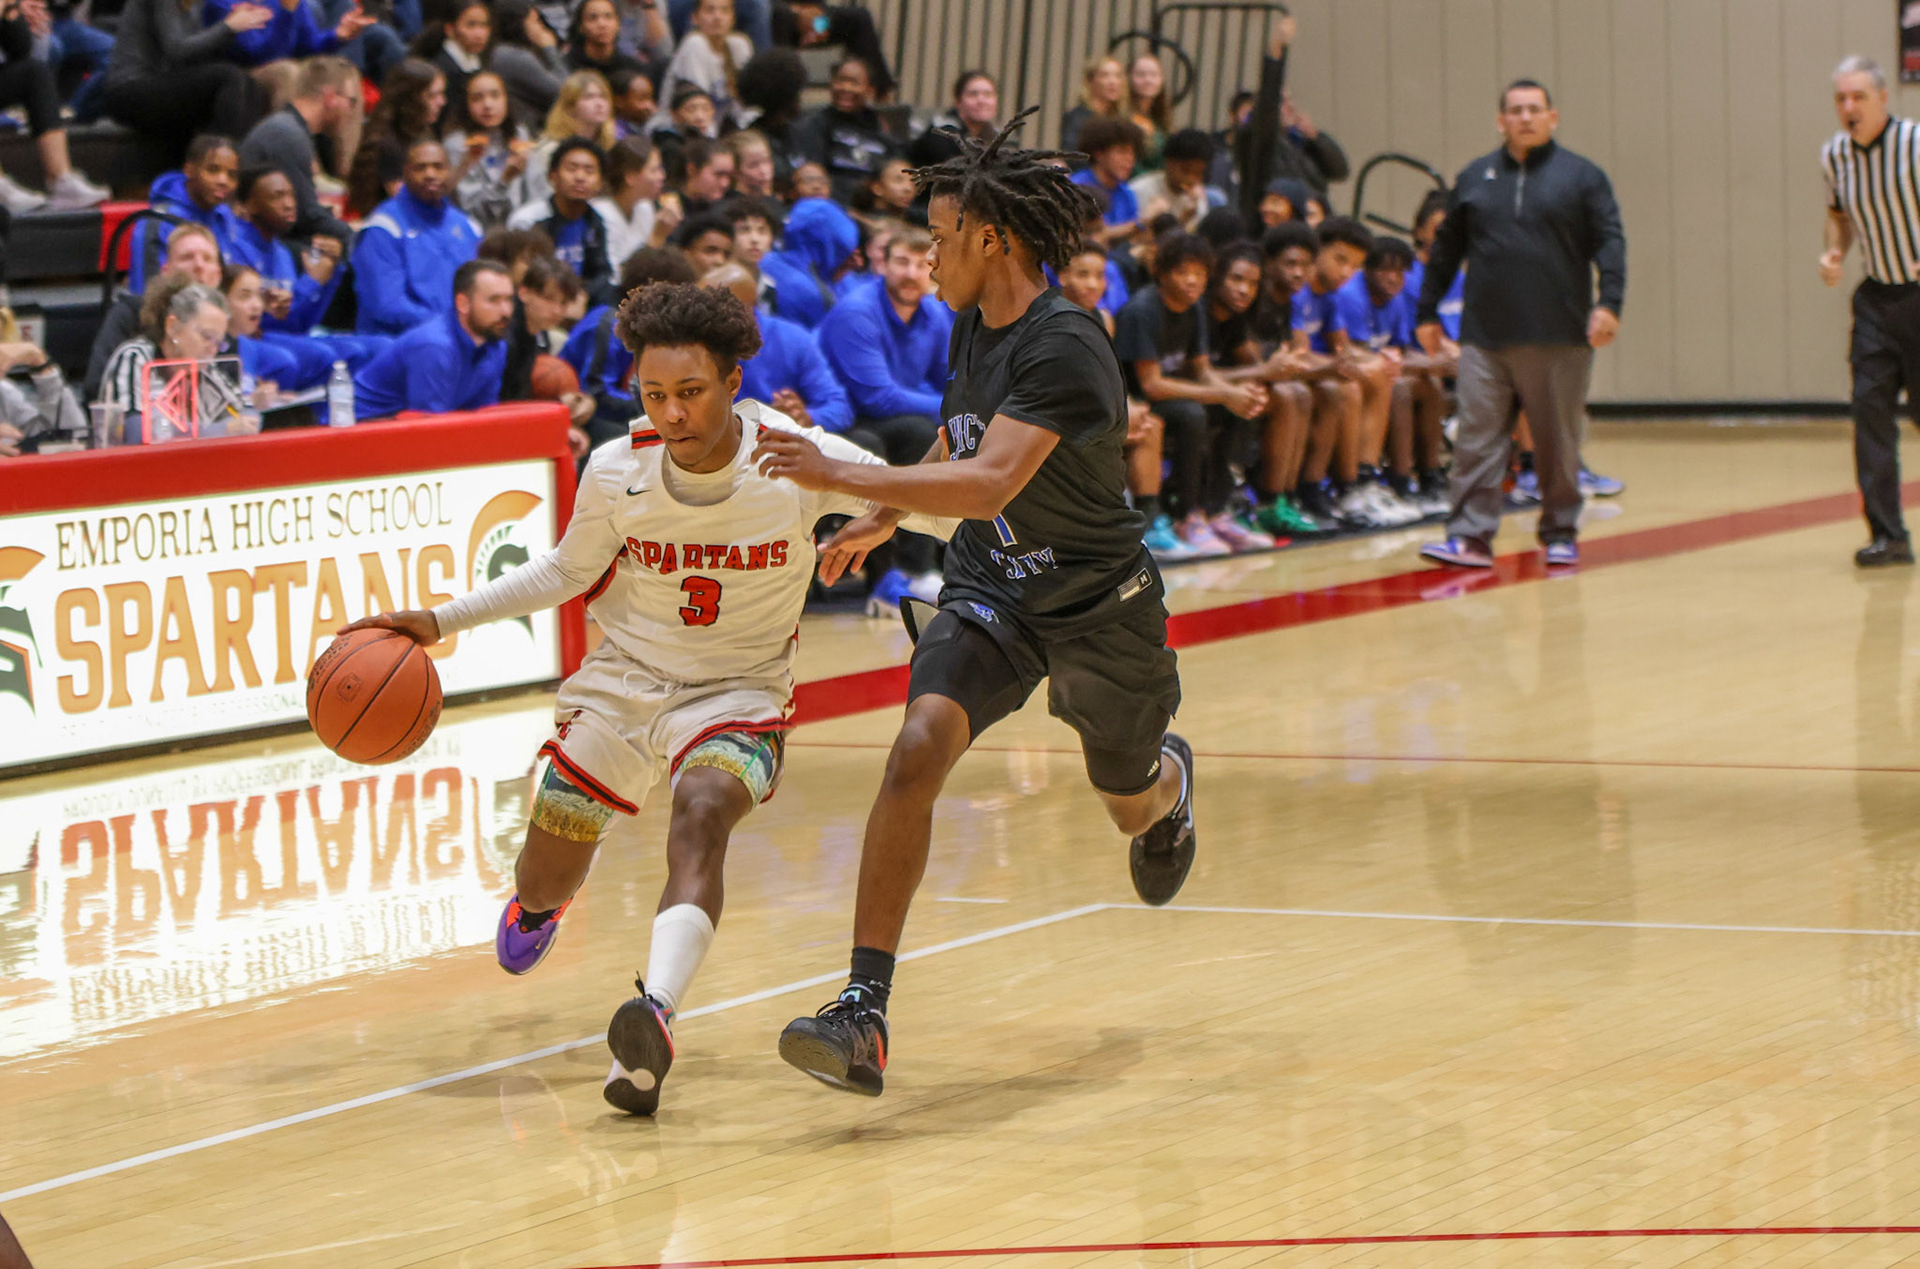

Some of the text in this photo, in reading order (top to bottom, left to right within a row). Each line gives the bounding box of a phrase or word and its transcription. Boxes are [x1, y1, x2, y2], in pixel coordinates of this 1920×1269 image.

[55, 481, 452, 571] EMPORIA HIGH SCHOOL
[626, 536, 789, 575] SPARTANS
[679, 575, 723, 627] 3
